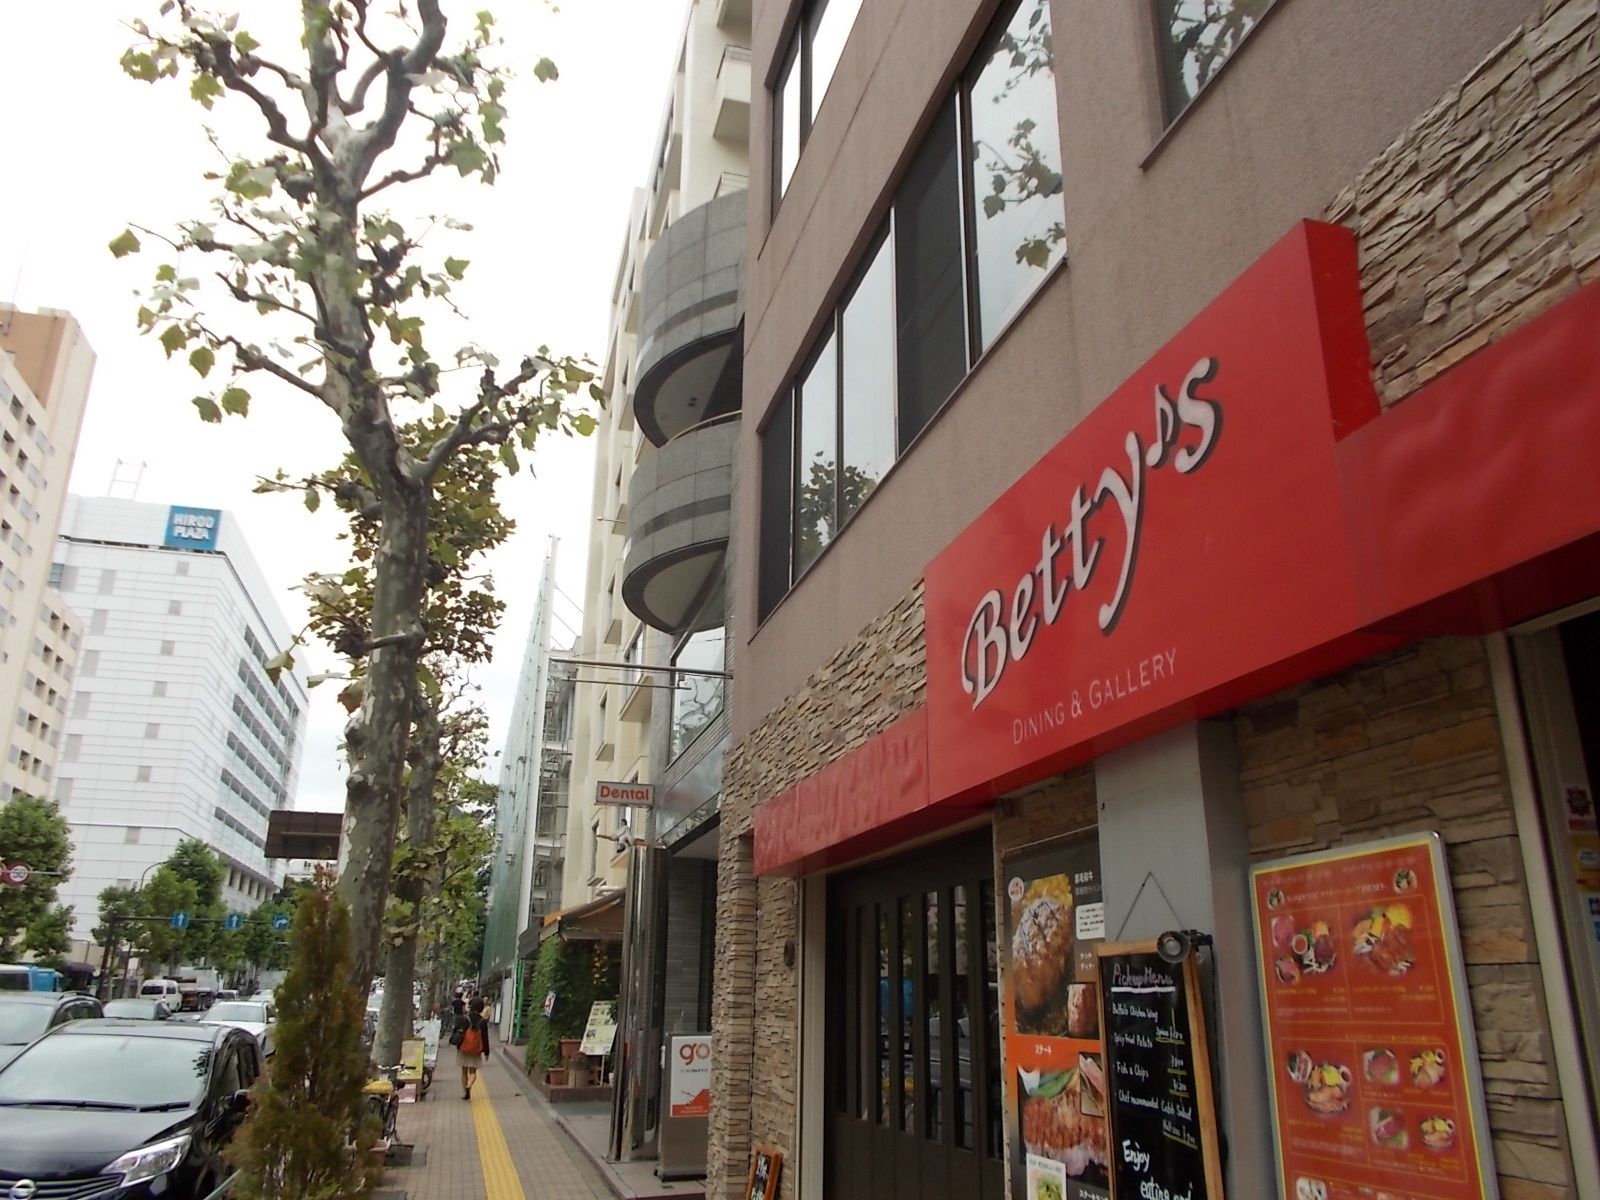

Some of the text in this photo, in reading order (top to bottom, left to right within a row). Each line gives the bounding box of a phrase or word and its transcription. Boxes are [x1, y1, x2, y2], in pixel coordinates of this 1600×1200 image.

[173, 525, 210, 540] PLAZA
[961, 357, 1218, 711] Betty's
[1071, 690, 1082, 718] &
[600, 785, 649, 801] Dental
[1116, 1061, 1128, 1075] Fish
[1134, 1063, 1149, 1082] Chips
[1122, 1139, 1150, 1173] Enjoy
